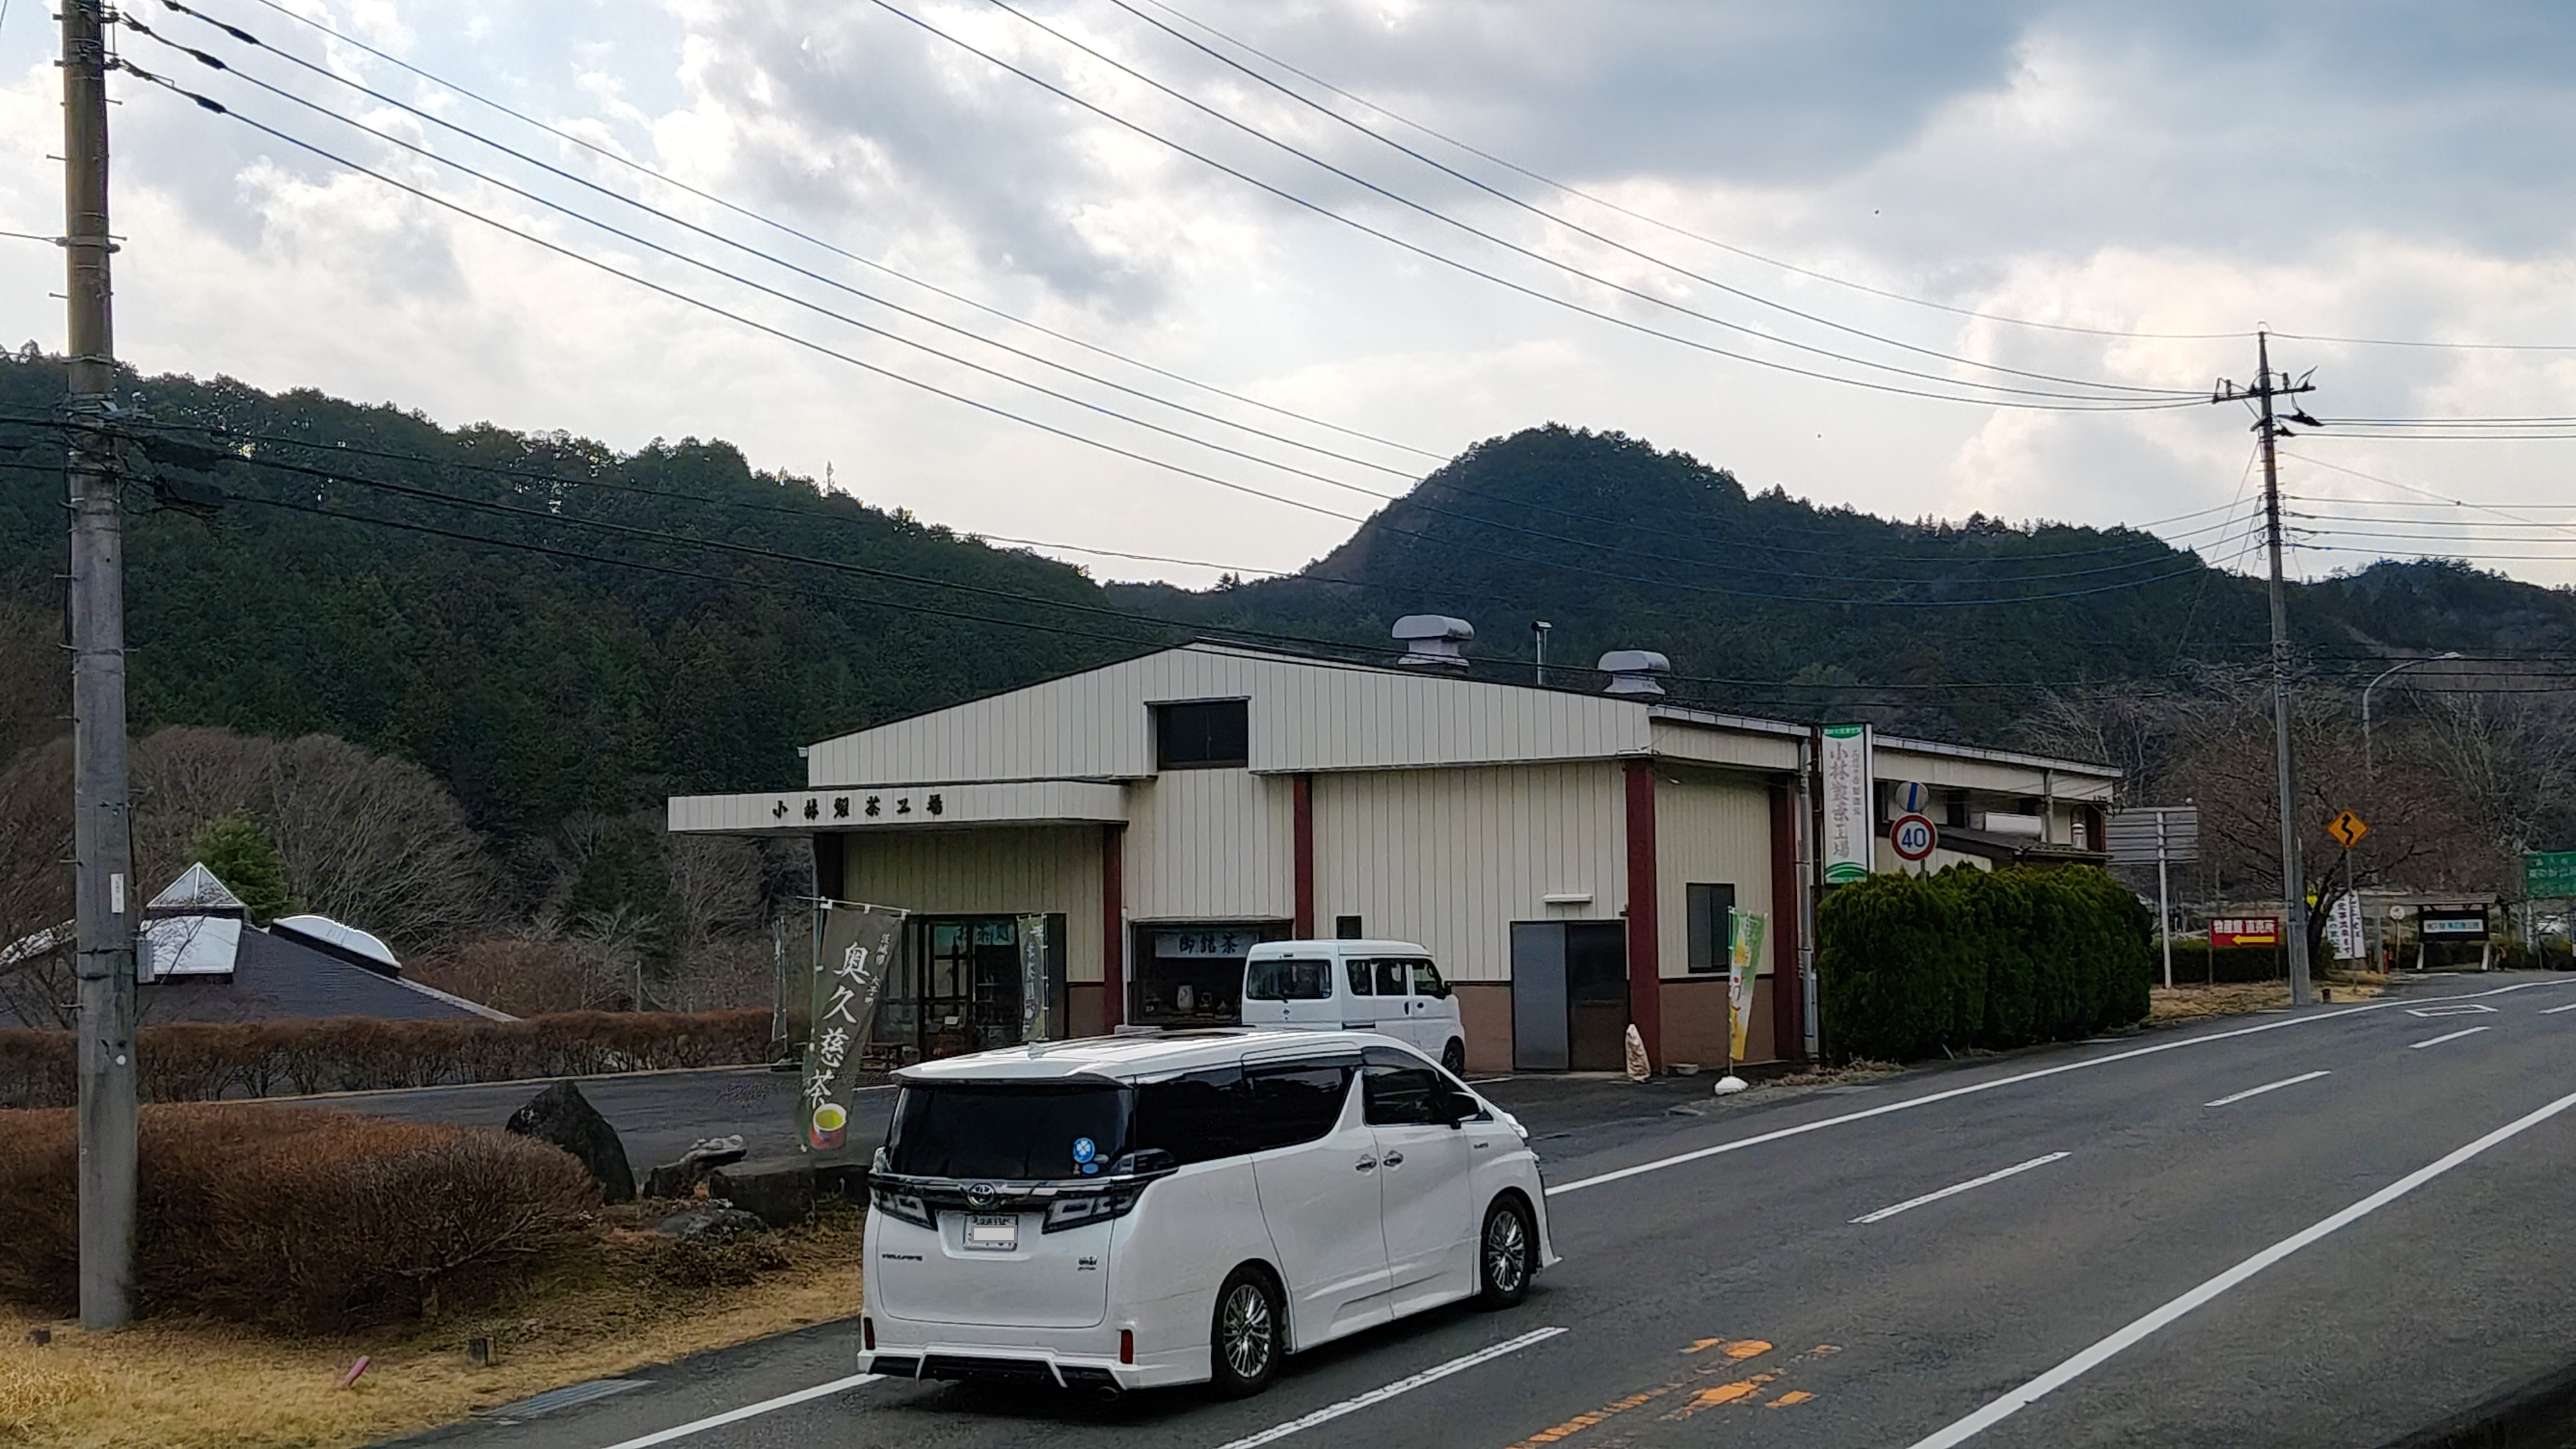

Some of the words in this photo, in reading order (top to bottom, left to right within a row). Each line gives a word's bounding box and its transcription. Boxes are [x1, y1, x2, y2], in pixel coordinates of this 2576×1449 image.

[772, 794, 943, 820] 小林製茶工場
[1901, 827, 1926, 848] 40
[803, 941, 870, 1109] 奥久慈茶
